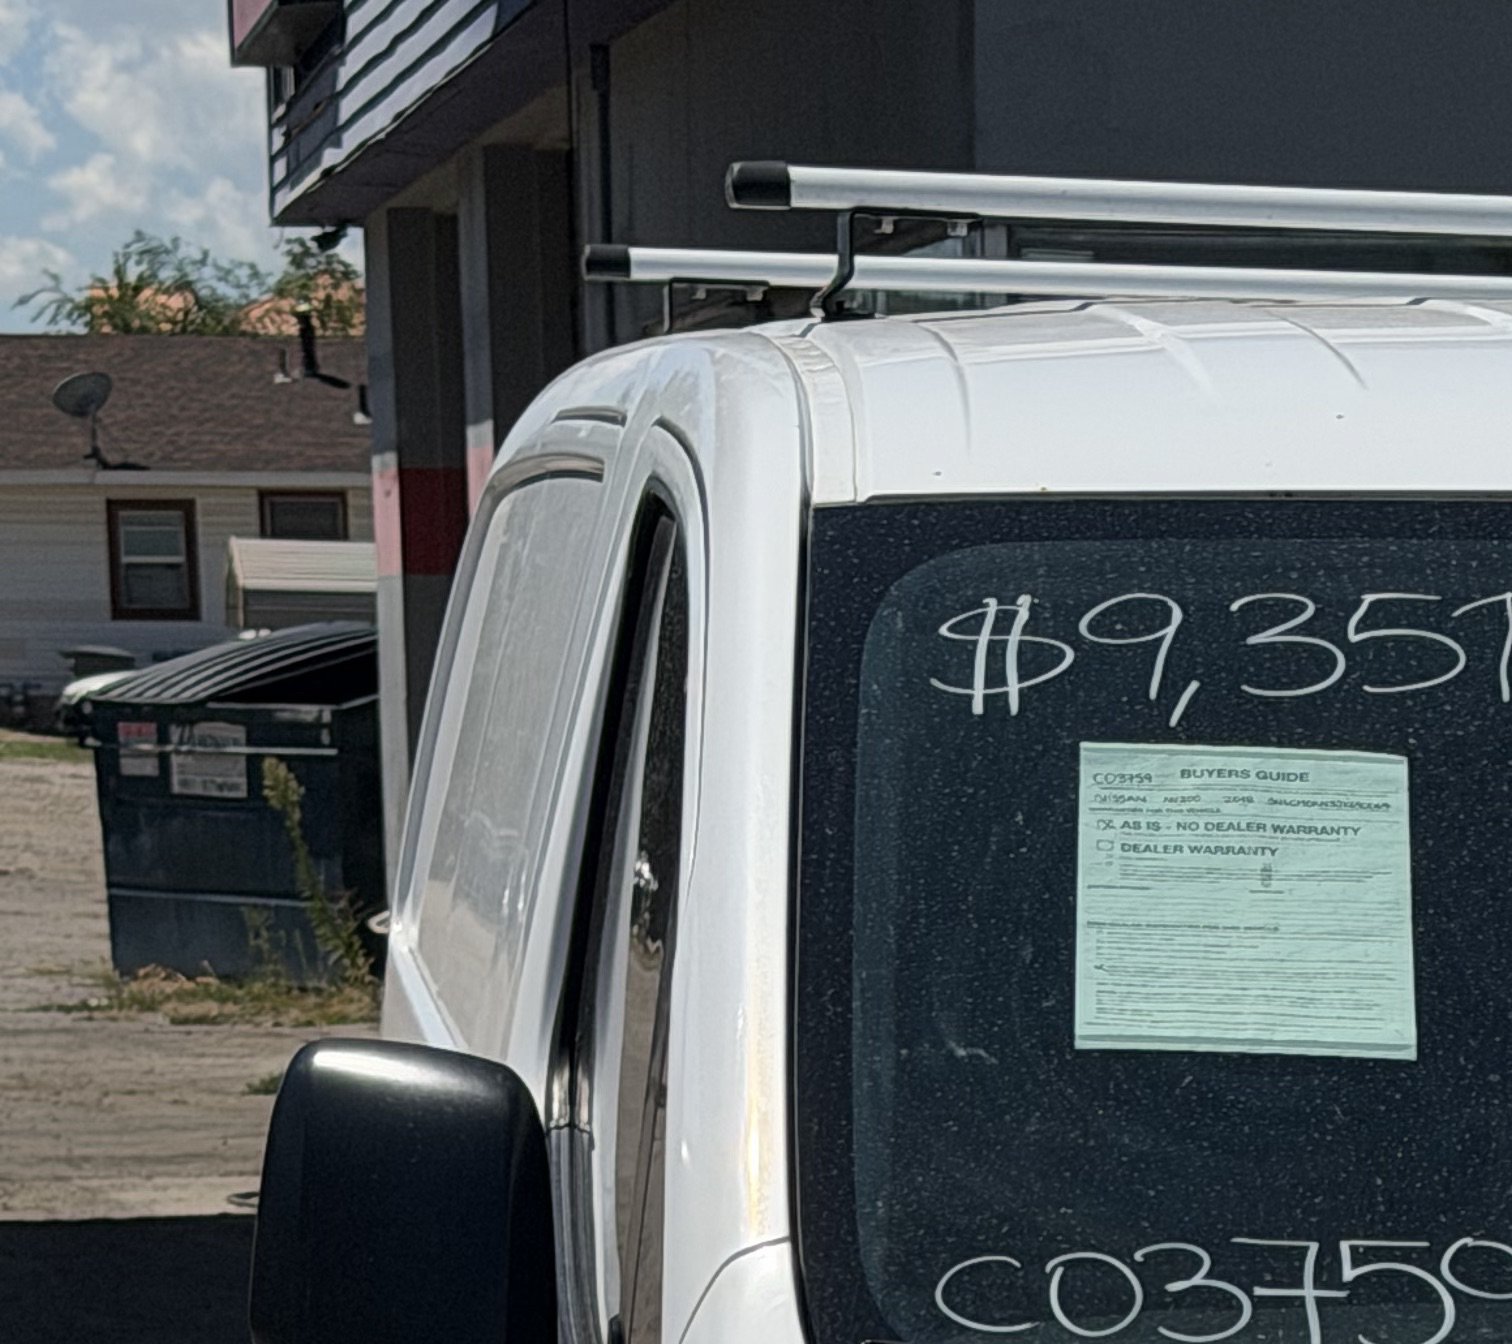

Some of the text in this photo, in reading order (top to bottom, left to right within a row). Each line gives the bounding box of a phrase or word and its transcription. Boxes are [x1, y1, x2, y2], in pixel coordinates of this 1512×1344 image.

[1180, 768, 1310, 782] BUYERS GUIDE
[1120, 820, 1142, 831] AS
[1146, 821, 1162, 831] IS
[1176, 821, 1200, 832] NO
[1204, 821, 1267, 833] DEALER
[1271, 823, 1362, 836] WARRANTY
[1120, 842, 1279, 857] DEALER WARRANTY
